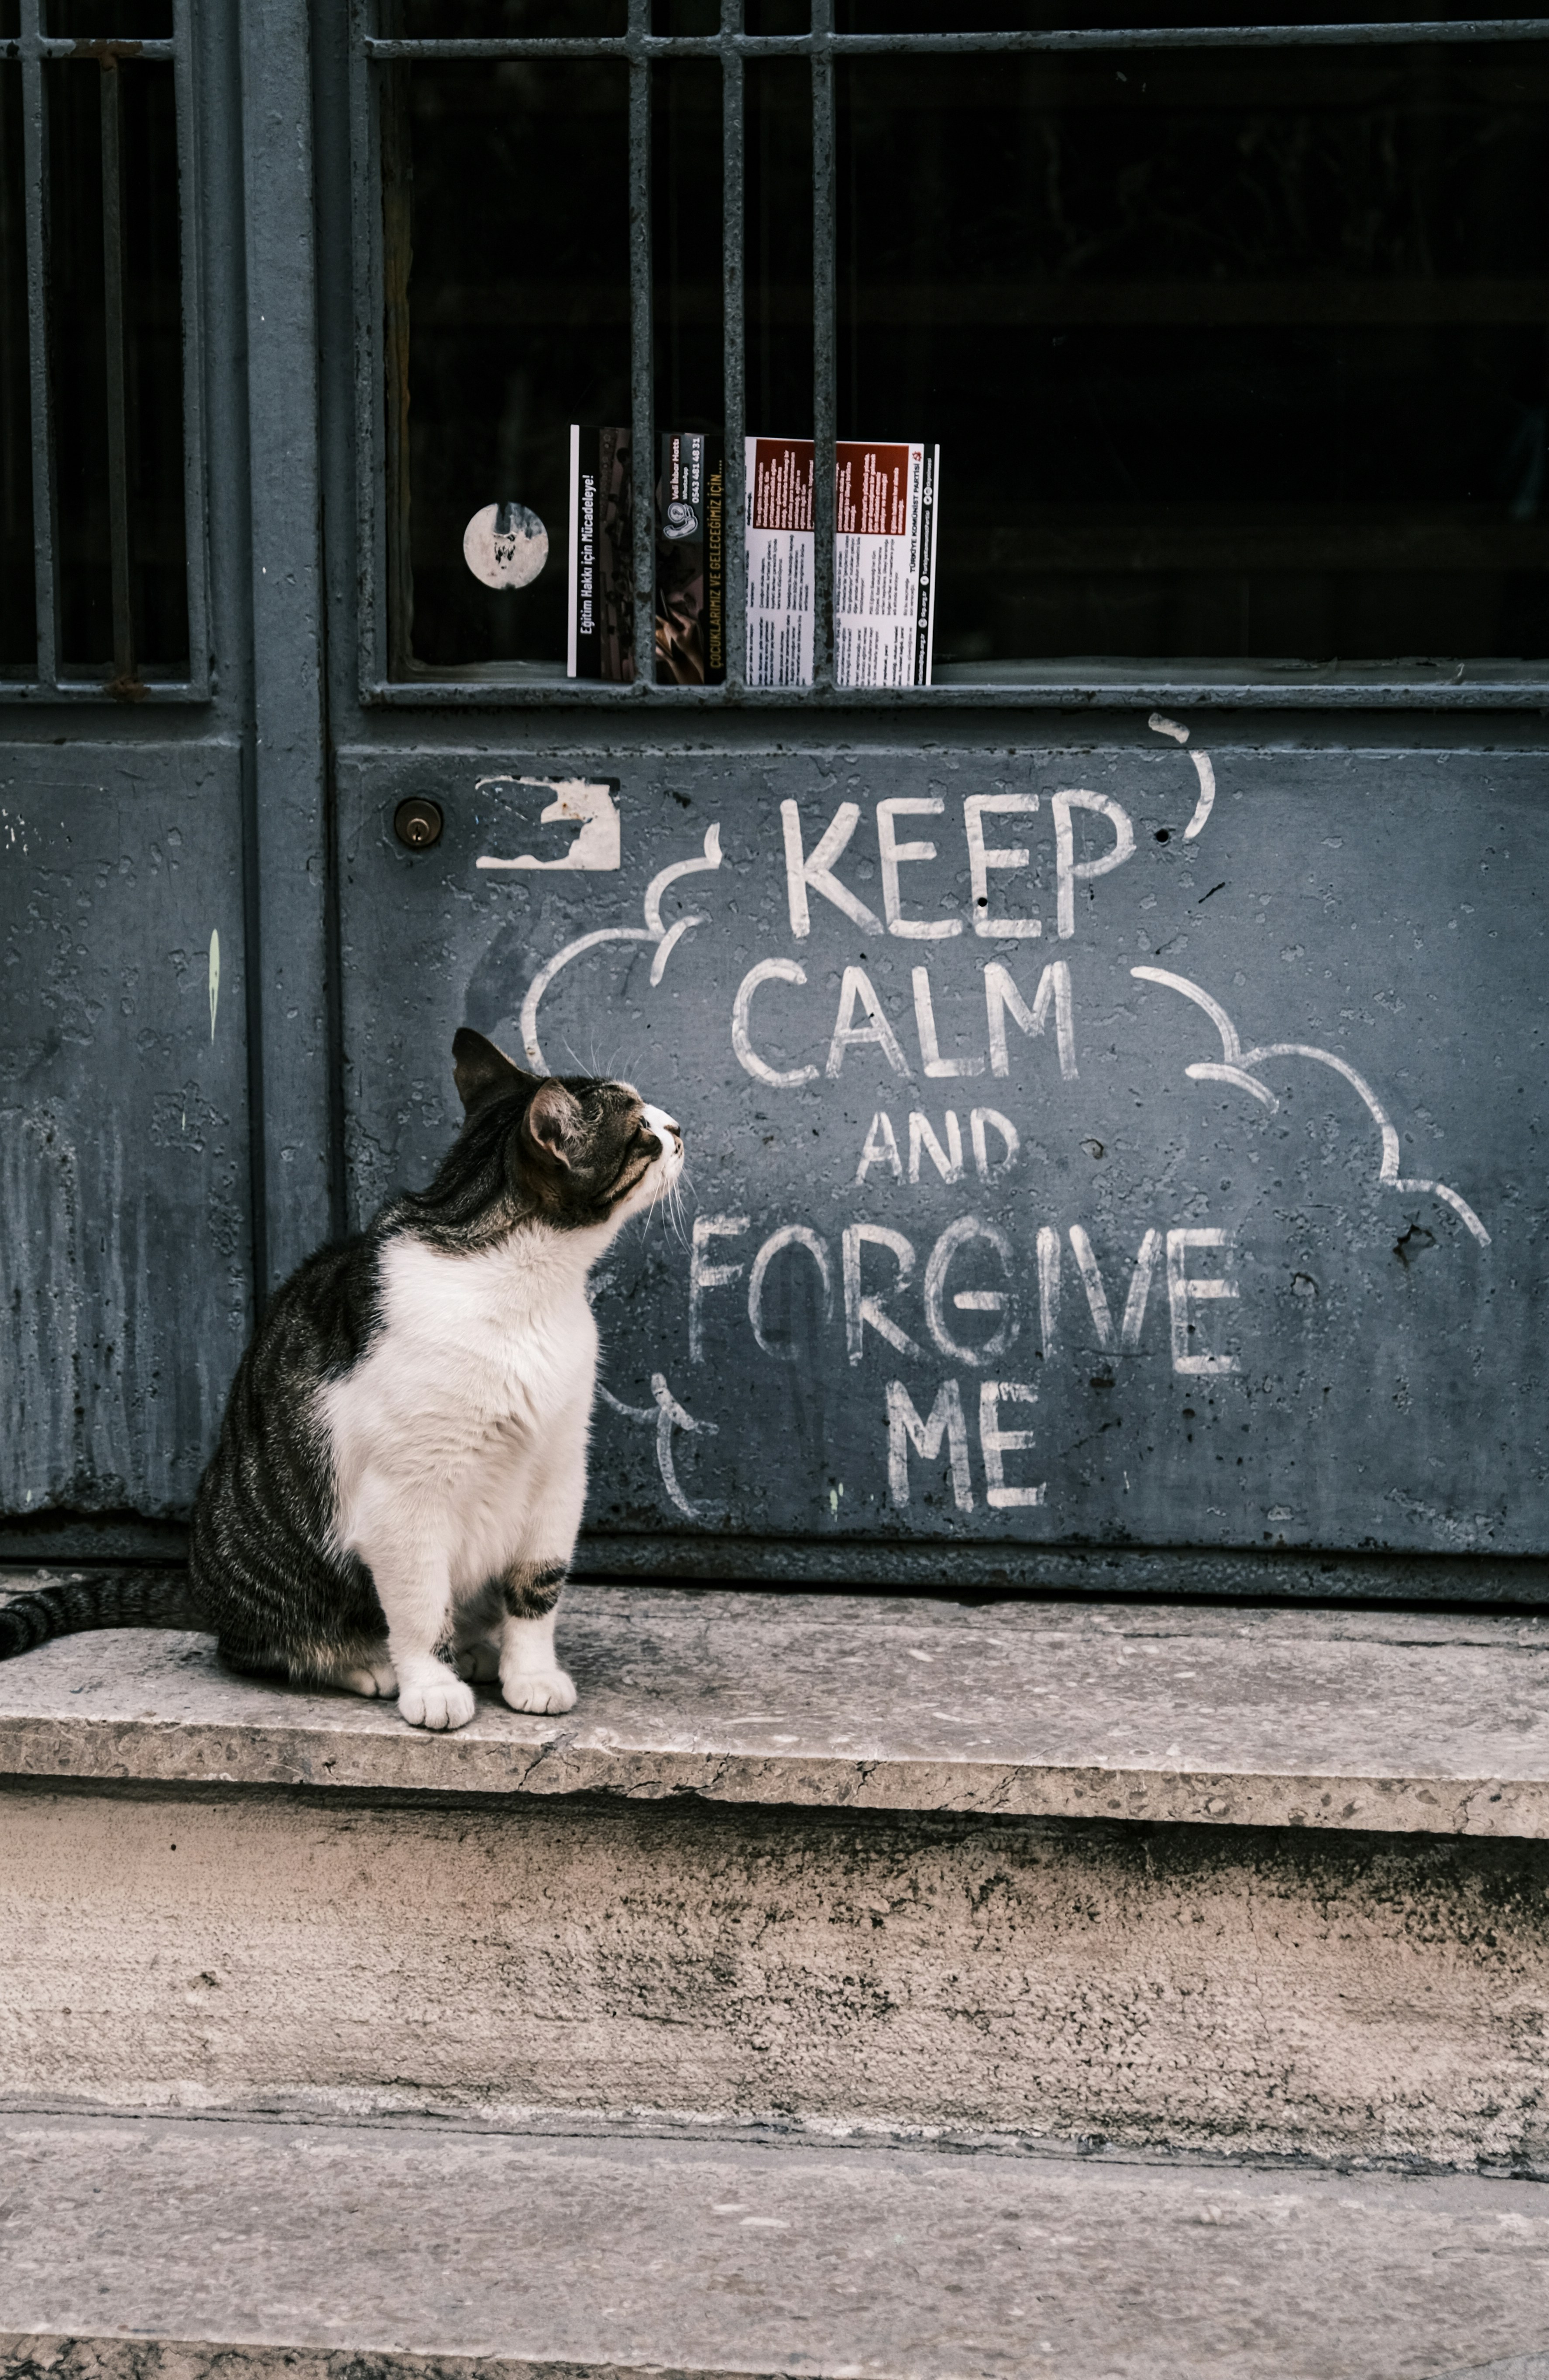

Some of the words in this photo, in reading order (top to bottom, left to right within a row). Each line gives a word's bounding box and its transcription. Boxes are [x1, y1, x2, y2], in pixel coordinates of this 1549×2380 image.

[692, 438, 700, 449] 31
[692, 450, 700, 462] 48
[670, 463, 679, 484] İhbar
[707, 460, 724, 496] İÇİN....
[581, 475, 595, 542] Mücadeleye!
[707, 499, 721, 569] GELECEĞİMİZ
[580, 545, 595, 564] için
[710, 572, 721, 586] VE
[580, 567, 592, 597] Hakkı
[580, 600, 594, 634] Eğitim
[709, 589, 722, 668] ÇOCUKLARIMIZ
[783, 790, 1137, 939] KEEP
[732, 957, 1078, 1088] CALM
[856, 1108, 1019, 1184] AND
[688, 1215, 1240, 1374] FORGIVE
[887, 1379, 1045, 1512] ME
